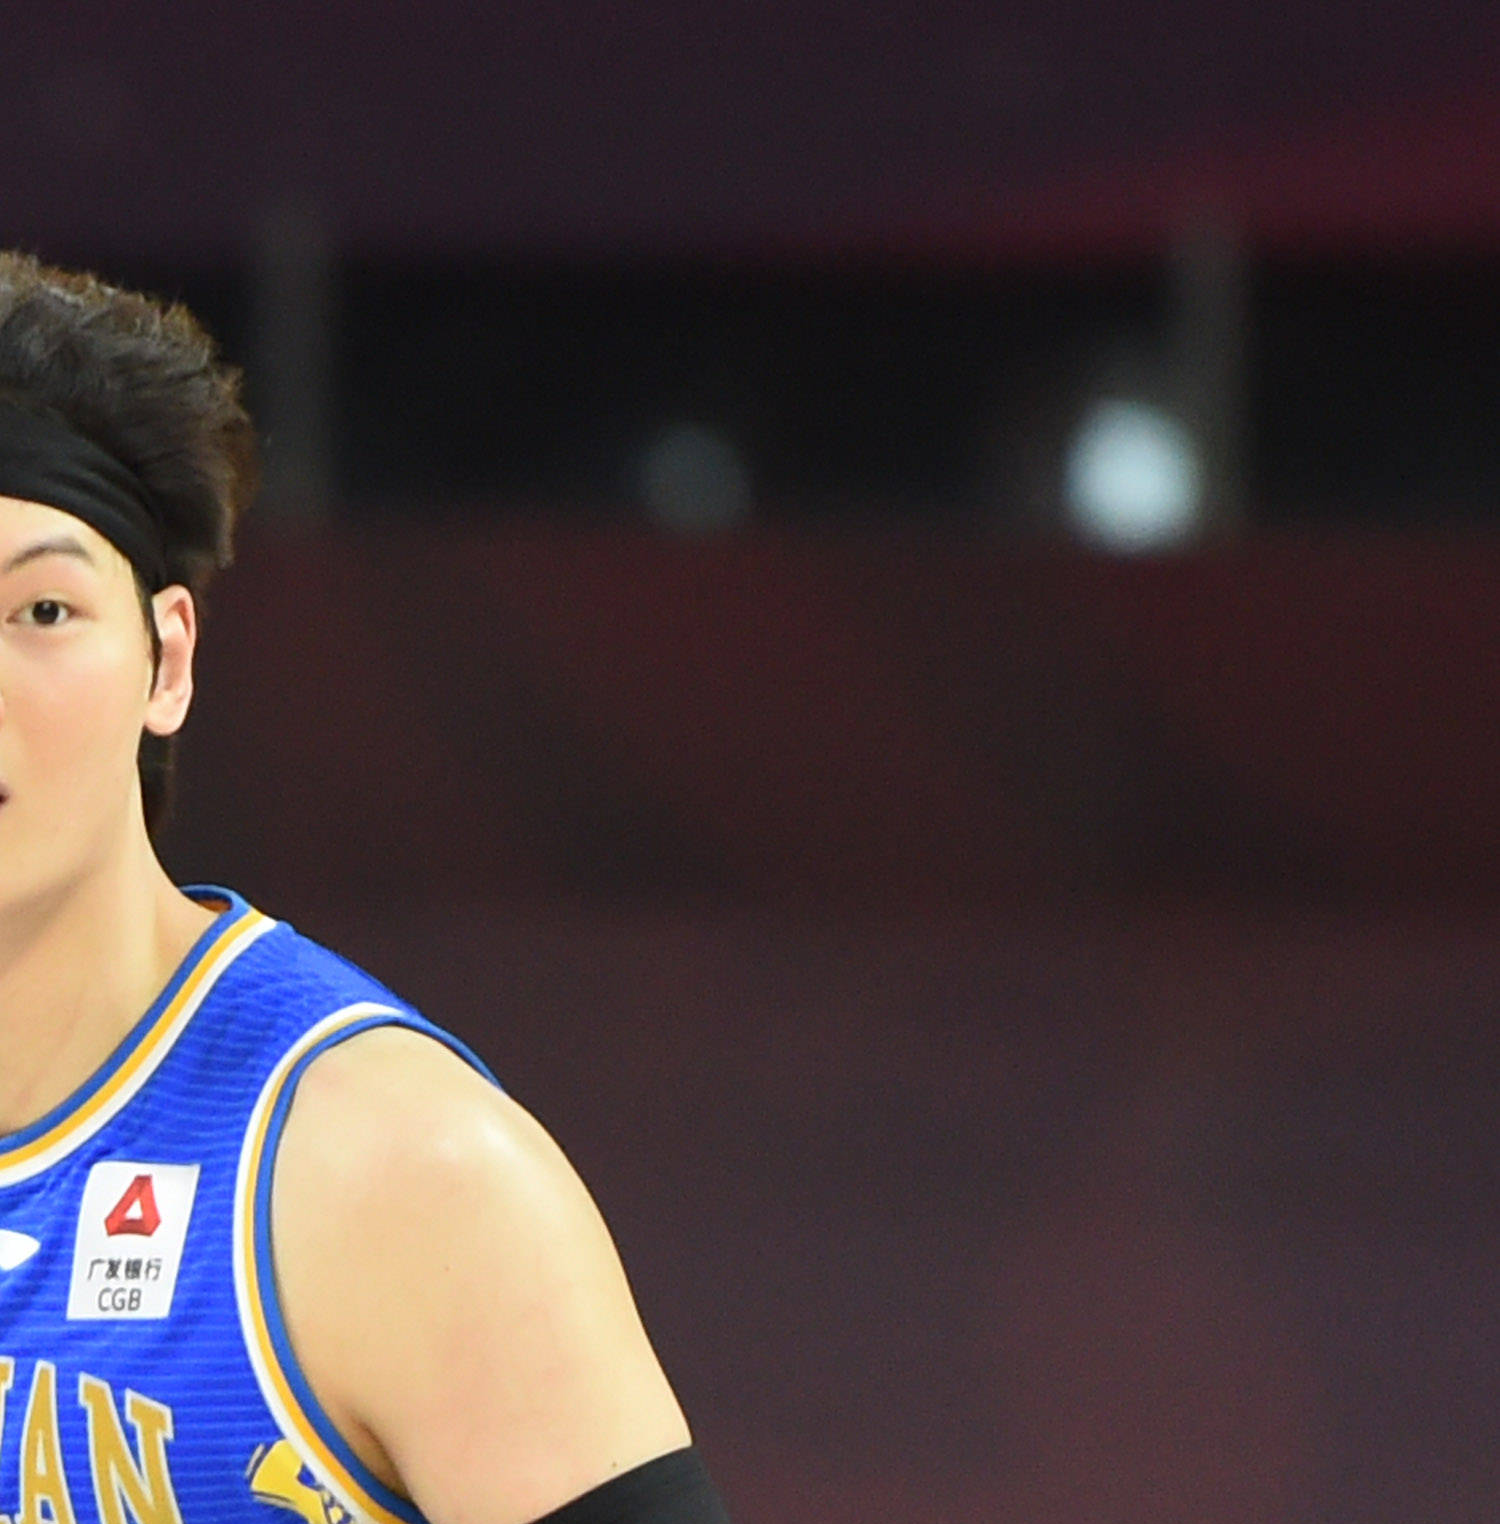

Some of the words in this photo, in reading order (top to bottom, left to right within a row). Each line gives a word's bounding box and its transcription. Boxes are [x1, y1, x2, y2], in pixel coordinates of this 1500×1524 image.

[87, 1257, 163, 1282] 广发银行
[97, 1286, 142, 1312] CGB
